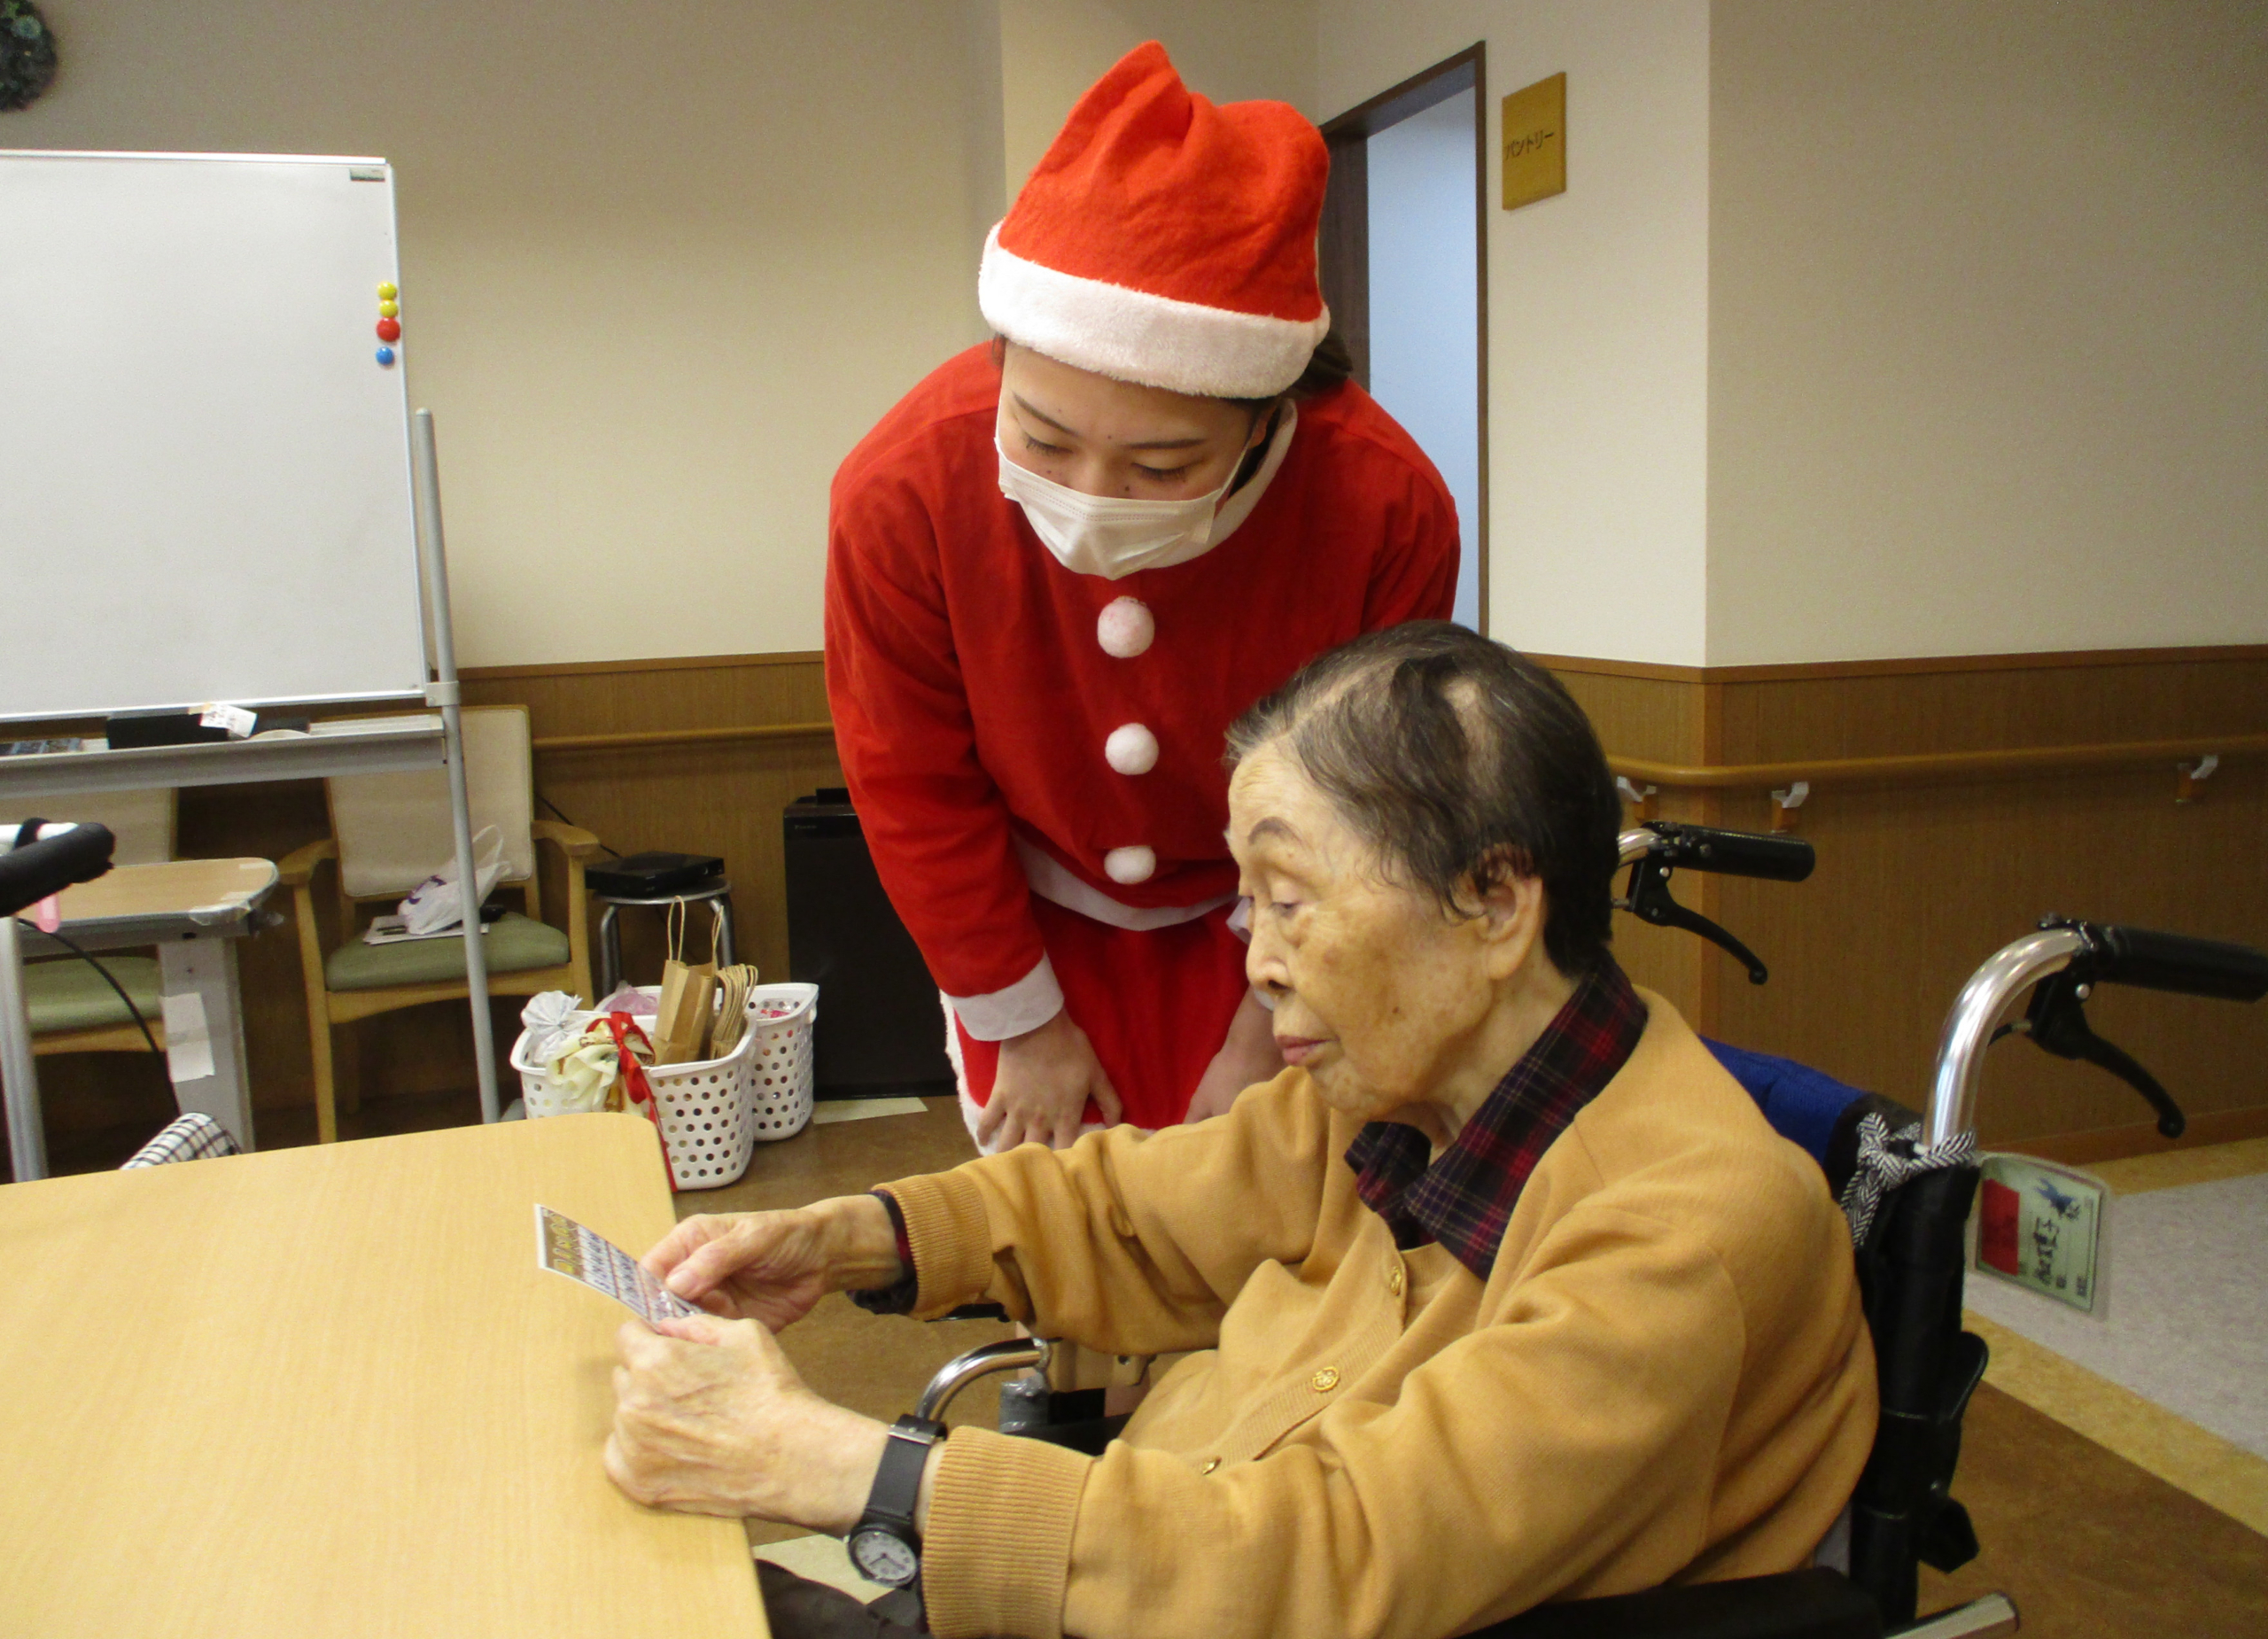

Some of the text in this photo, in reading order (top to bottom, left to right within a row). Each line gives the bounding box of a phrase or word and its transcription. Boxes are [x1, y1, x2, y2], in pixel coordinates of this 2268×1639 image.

[1505, 129, 1555, 160] パントリー
